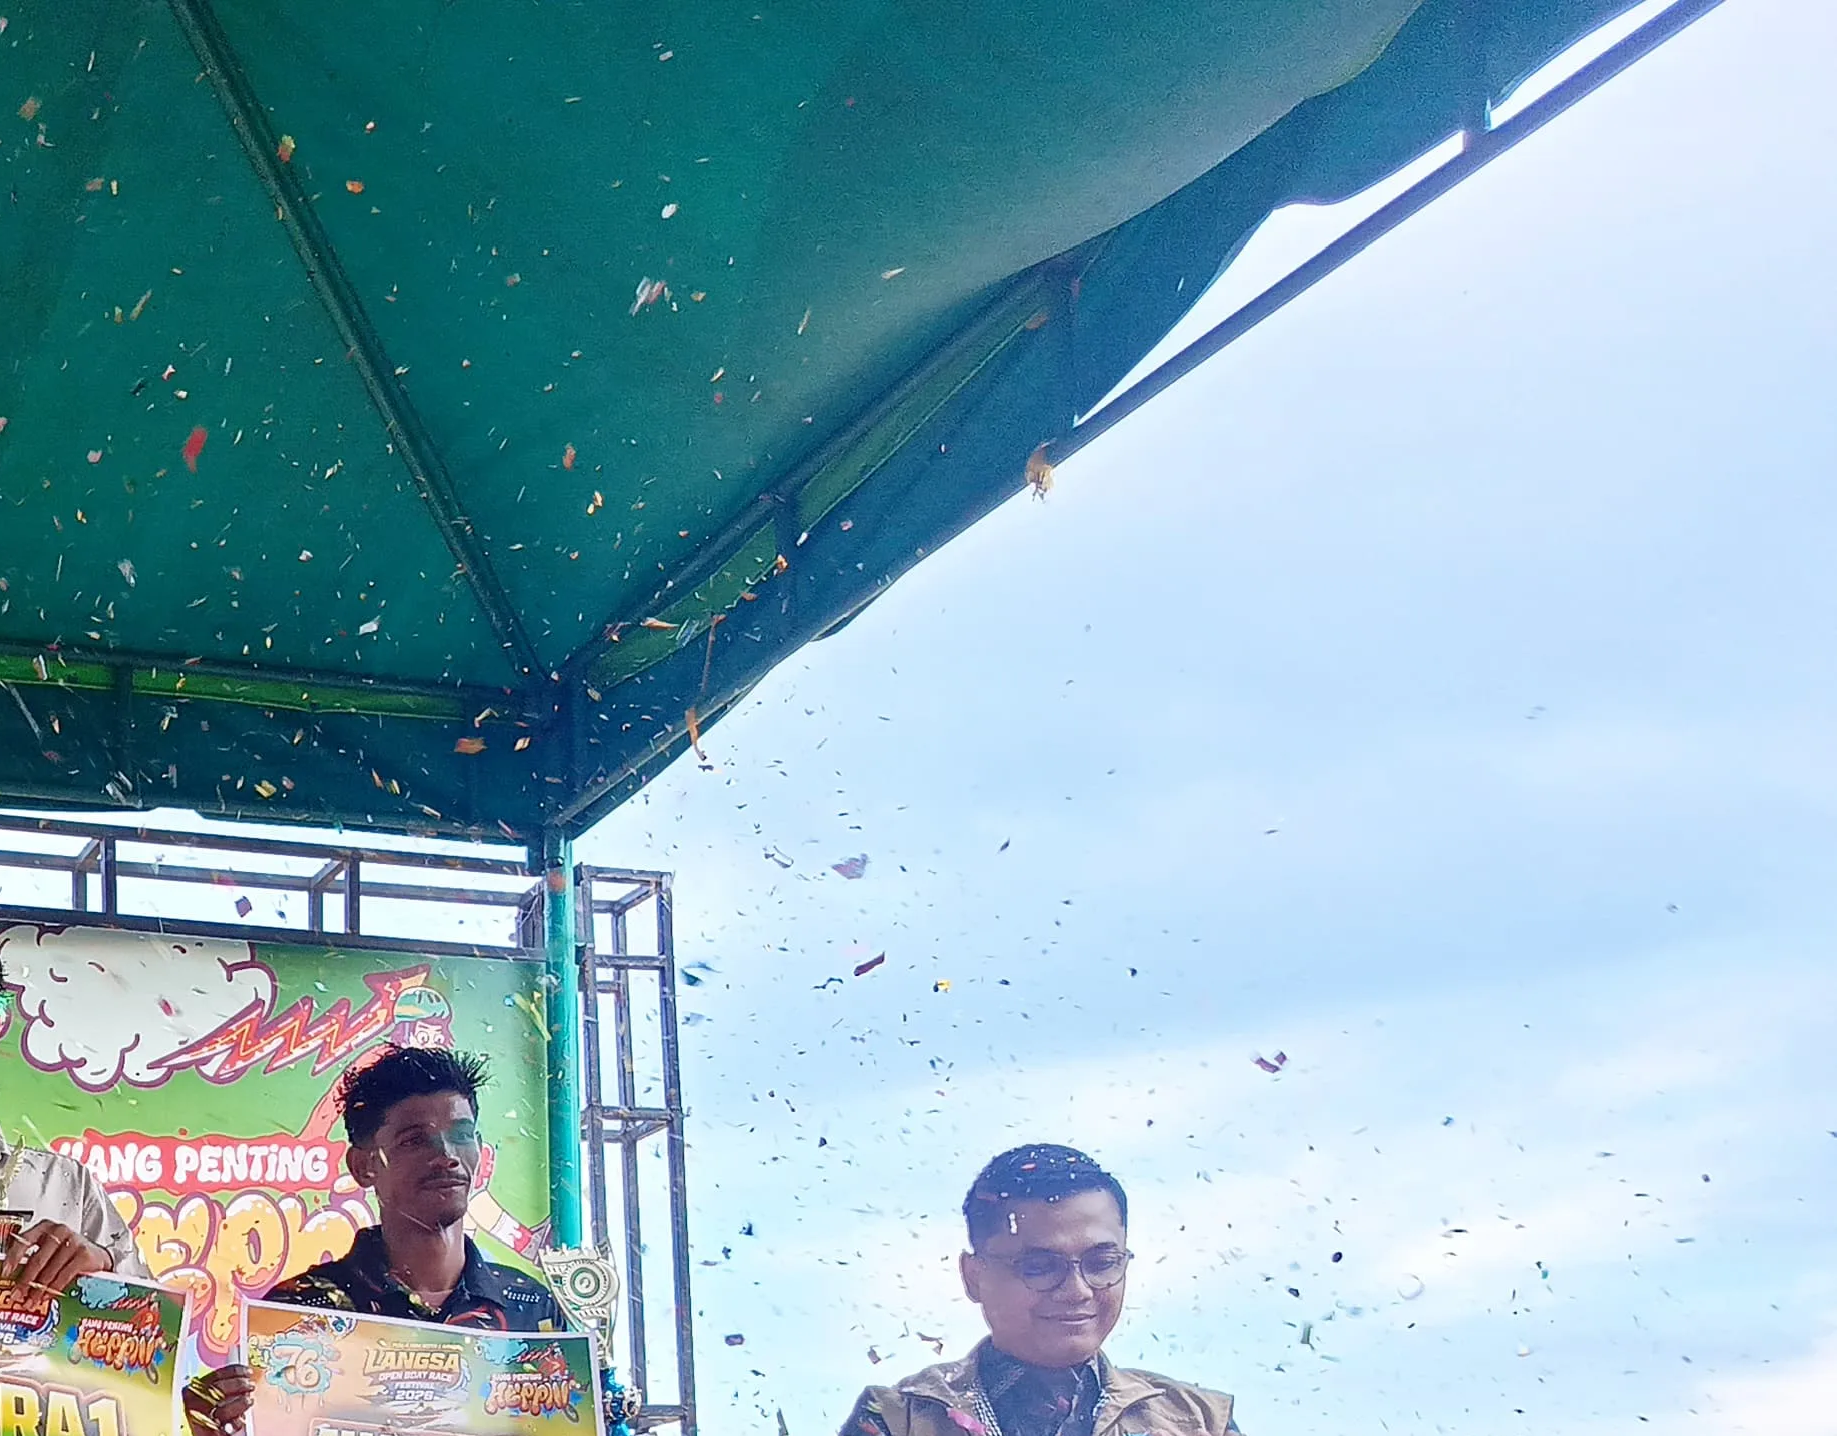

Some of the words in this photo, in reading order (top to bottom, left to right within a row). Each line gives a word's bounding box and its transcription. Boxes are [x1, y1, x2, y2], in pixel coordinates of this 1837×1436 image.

[11, 1312, 40, 1326] RACE
[272, 1343, 322, 1388] 76
[364, 1349, 460, 1375] LANGSA
[378, 1371, 403, 1381] OPEN
[428, 1371, 453, 1382] RACE
